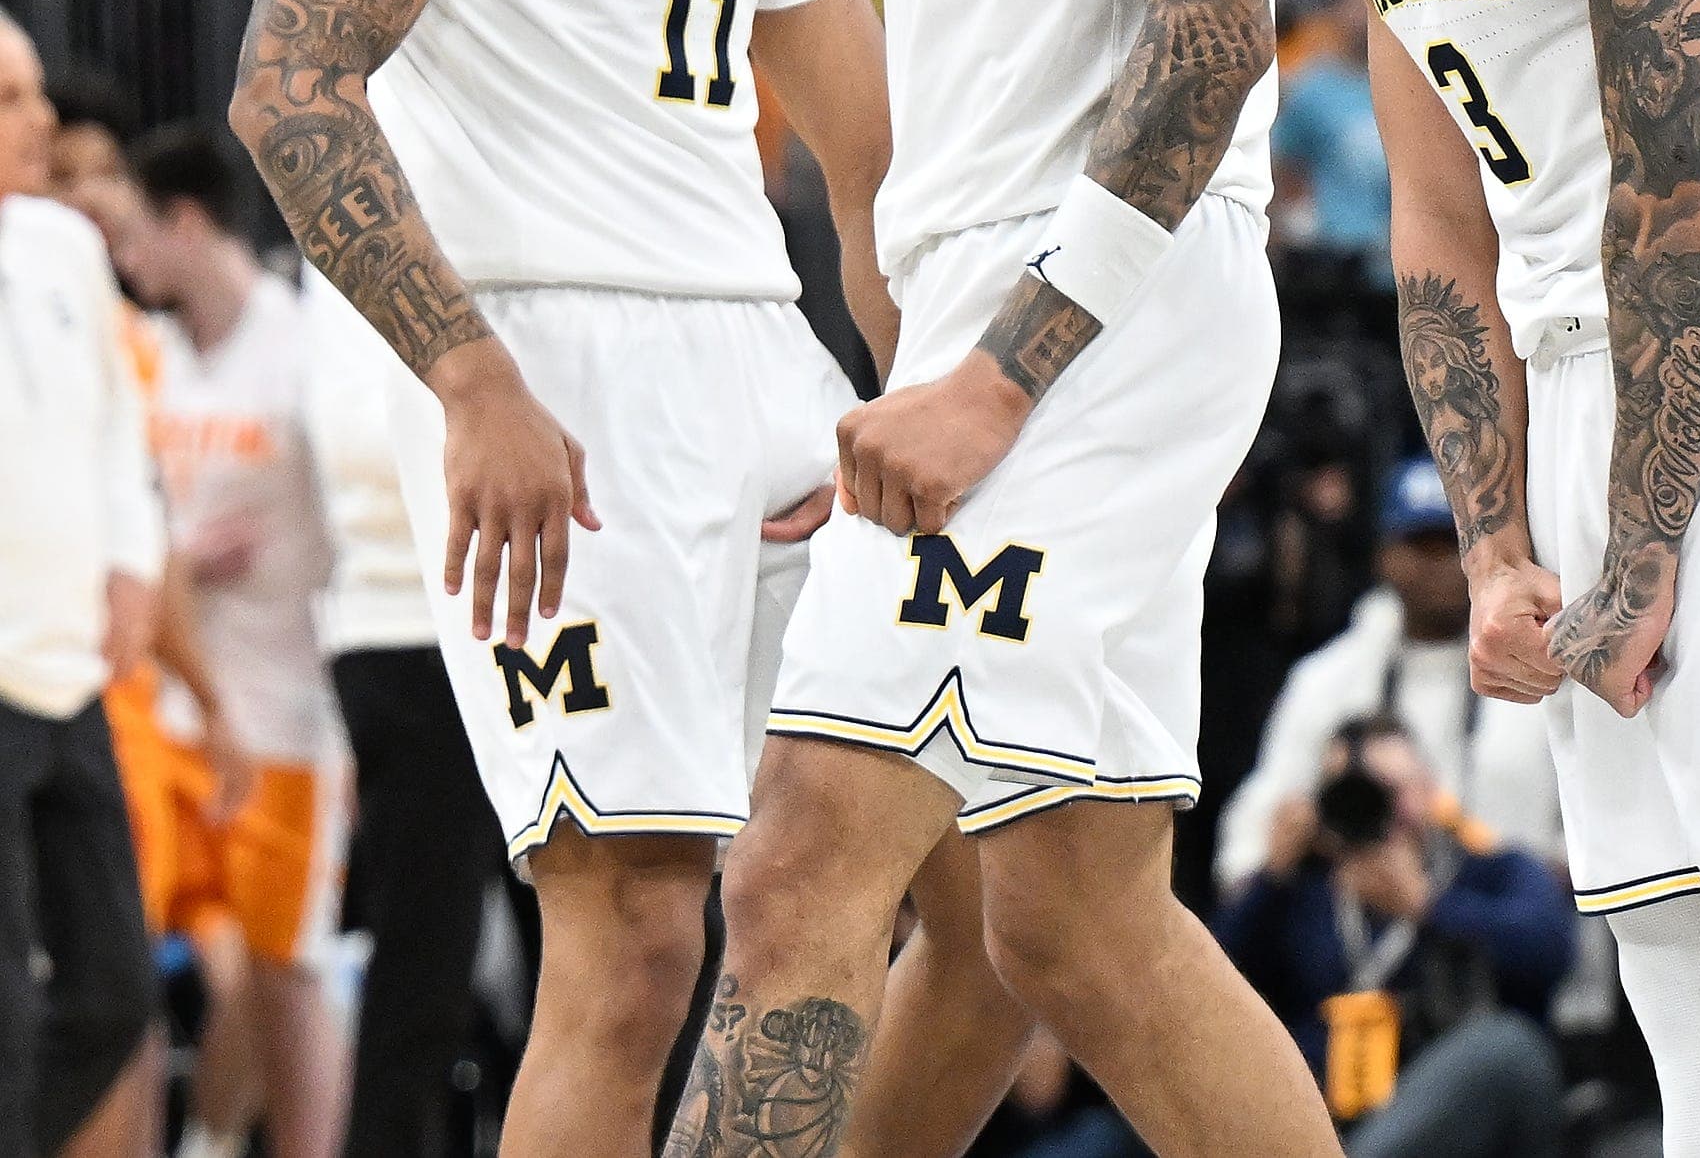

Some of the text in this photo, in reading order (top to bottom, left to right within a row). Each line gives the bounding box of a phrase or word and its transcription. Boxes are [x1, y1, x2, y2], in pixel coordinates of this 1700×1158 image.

[1426, 38, 1534, 188] 3
[896, 532, 1048, 645] M
[493, 621, 609, 731] M
